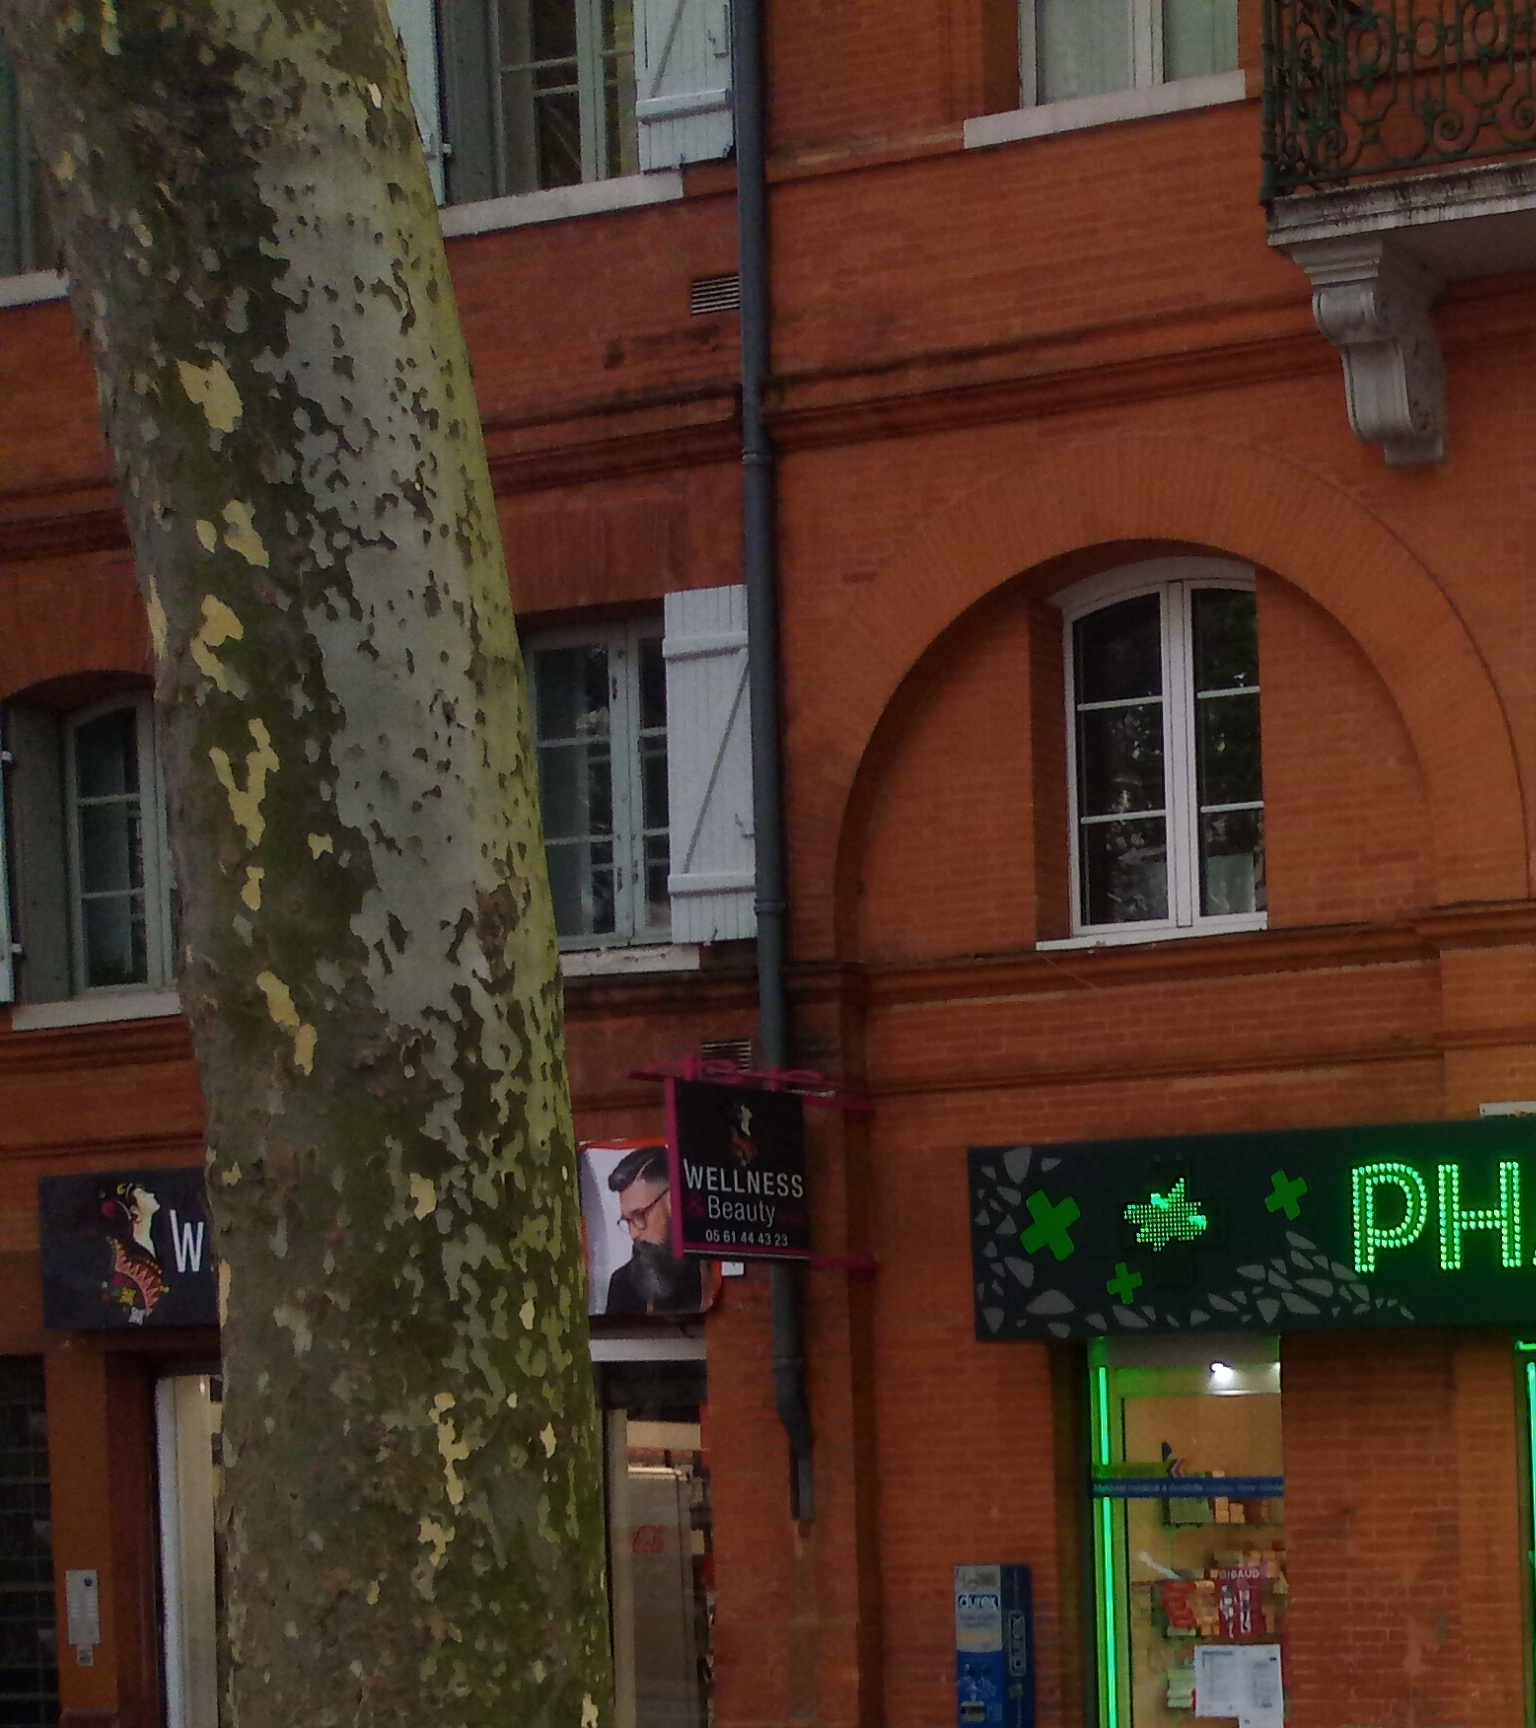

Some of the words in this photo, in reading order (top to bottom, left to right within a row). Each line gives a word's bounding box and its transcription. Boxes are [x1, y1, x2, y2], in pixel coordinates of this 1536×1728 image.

[683, 1157, 804, 1199] WELLNESS
[707, 1194, 776, 1228] Beauty
[705, 1229, 721, 1244] 05
[723, 1230, 737, 1244] 61
[740, 1232, 755, 1245] 44
[757, 1232, 772, 1246] 43
[774, 1233, 789, 1248] 23
[1217, 1567, 1261, 1580] GIBAUD
